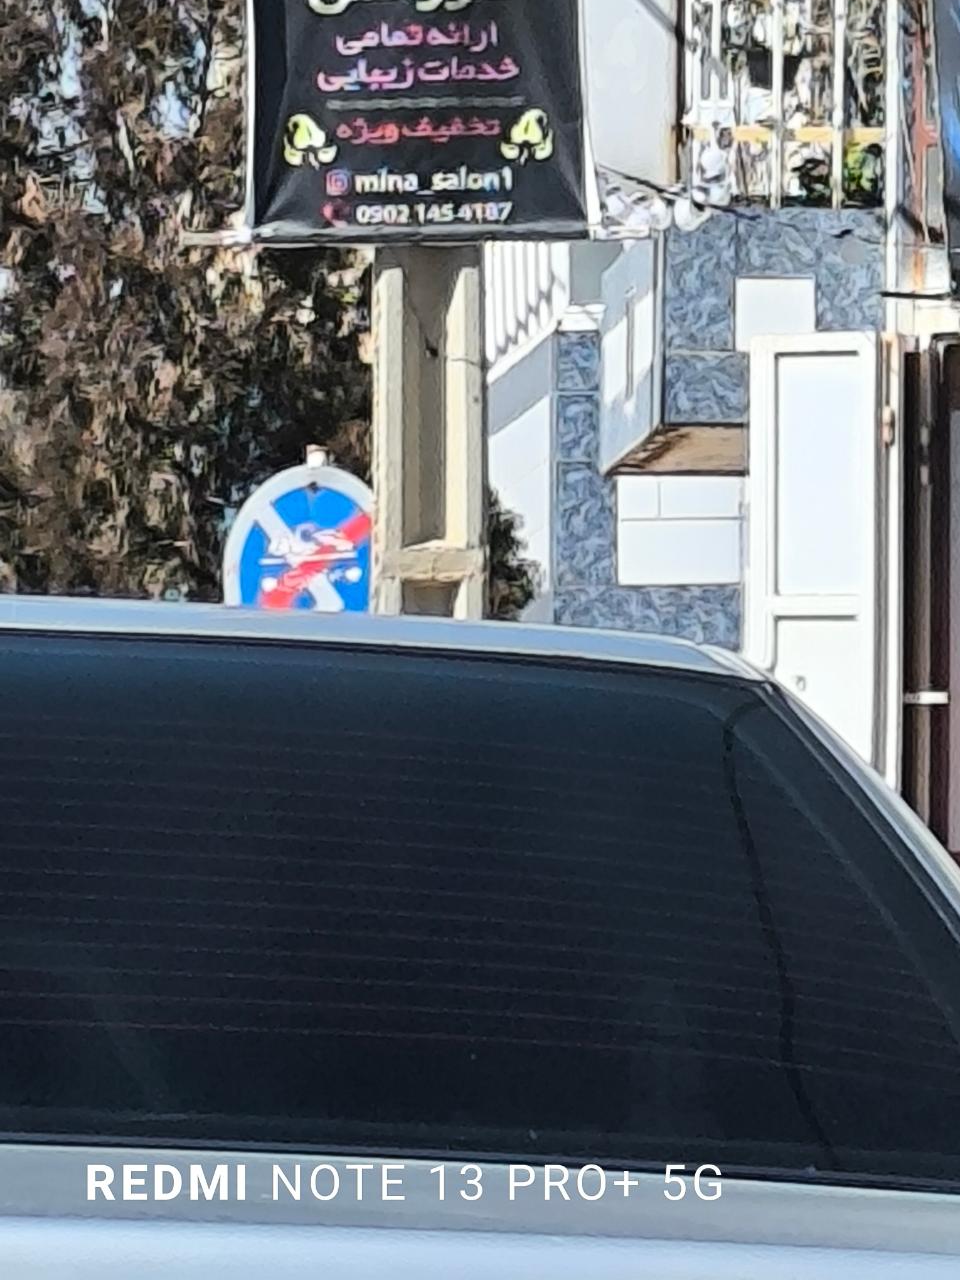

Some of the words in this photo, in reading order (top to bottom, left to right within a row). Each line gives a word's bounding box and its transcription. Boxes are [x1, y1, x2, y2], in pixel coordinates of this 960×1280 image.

[335, 21, 424, 56] تمامی
[316, 58, 415, 92] زیبایی
[417, 55, 521, 83] خدمات
[335, 117, 400, 145] ویژه
[402, 116, 502, 144] تخفیف
